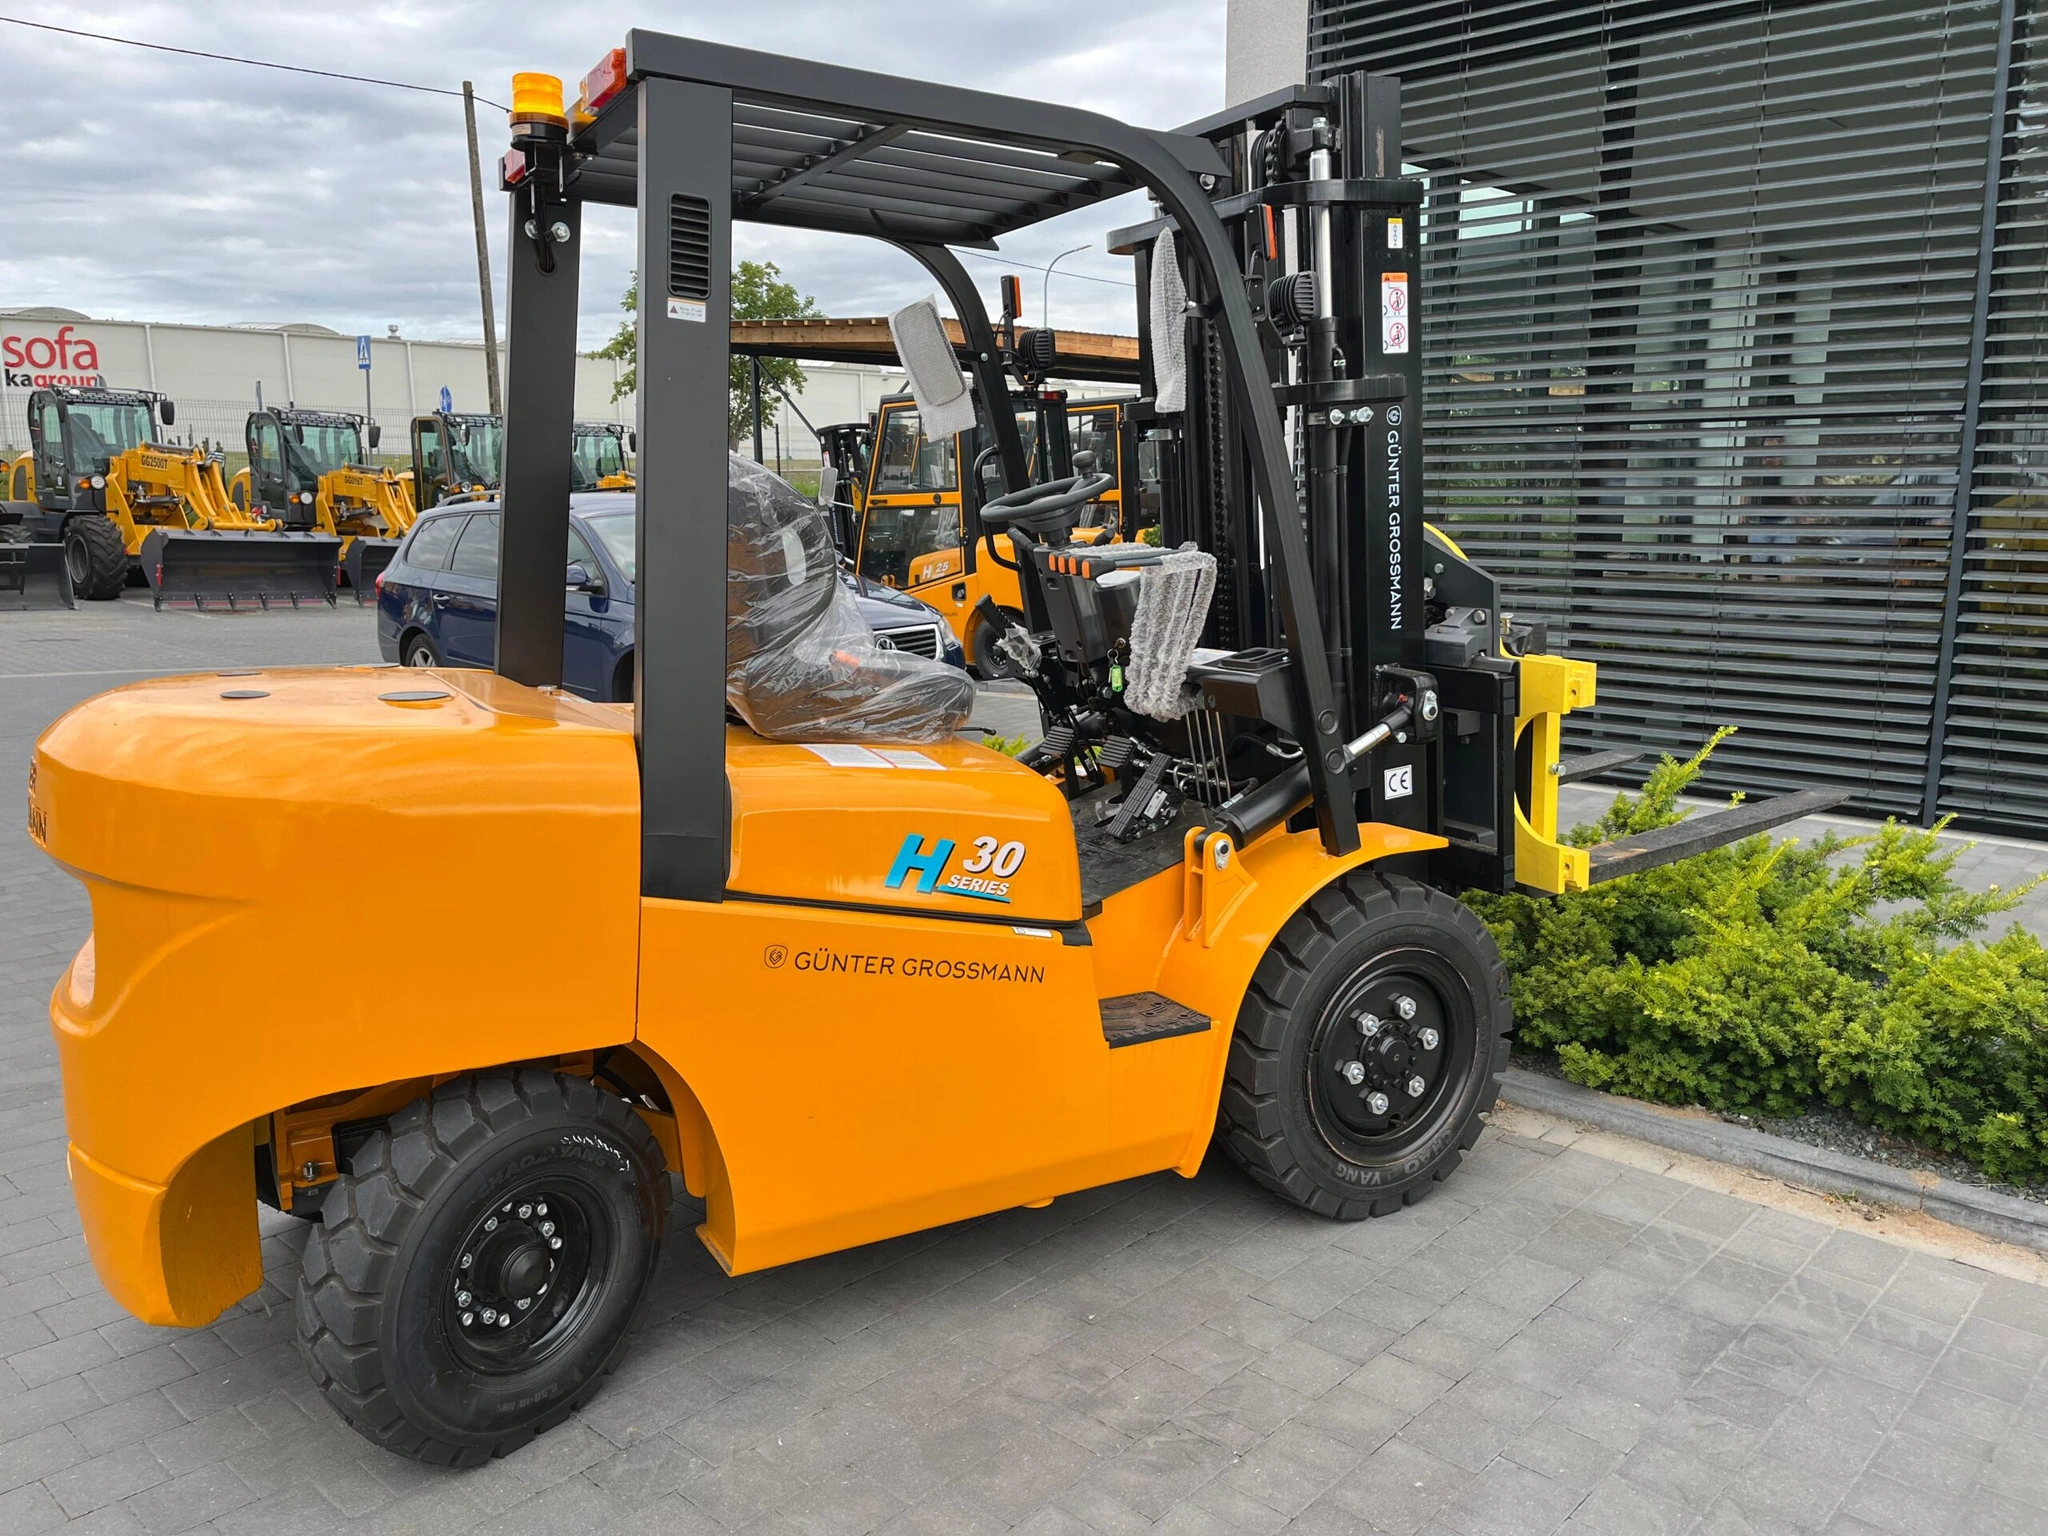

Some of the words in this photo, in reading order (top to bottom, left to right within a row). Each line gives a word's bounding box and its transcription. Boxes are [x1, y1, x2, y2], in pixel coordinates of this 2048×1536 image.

[2, 326, 99, 370] sofa
[1387, 430, 1402, 508] GÜNTER
[922, 564, 933, 580] H
[935, 561, 949, 573] 25
[1388, 512, 1402, 630] GROSSMANN
[1388, 771, 1408, 792] CE
[885, 833, 956, 894] H
[963, 836, 1026, 878] 30
[947, 875, 1010, 896] SERIES
[794, 947, 896, 975] GÜNTER
[902, 958, 1045, 983] GROSSMANN
[1336, 1163, 1381, 1185] YANG
